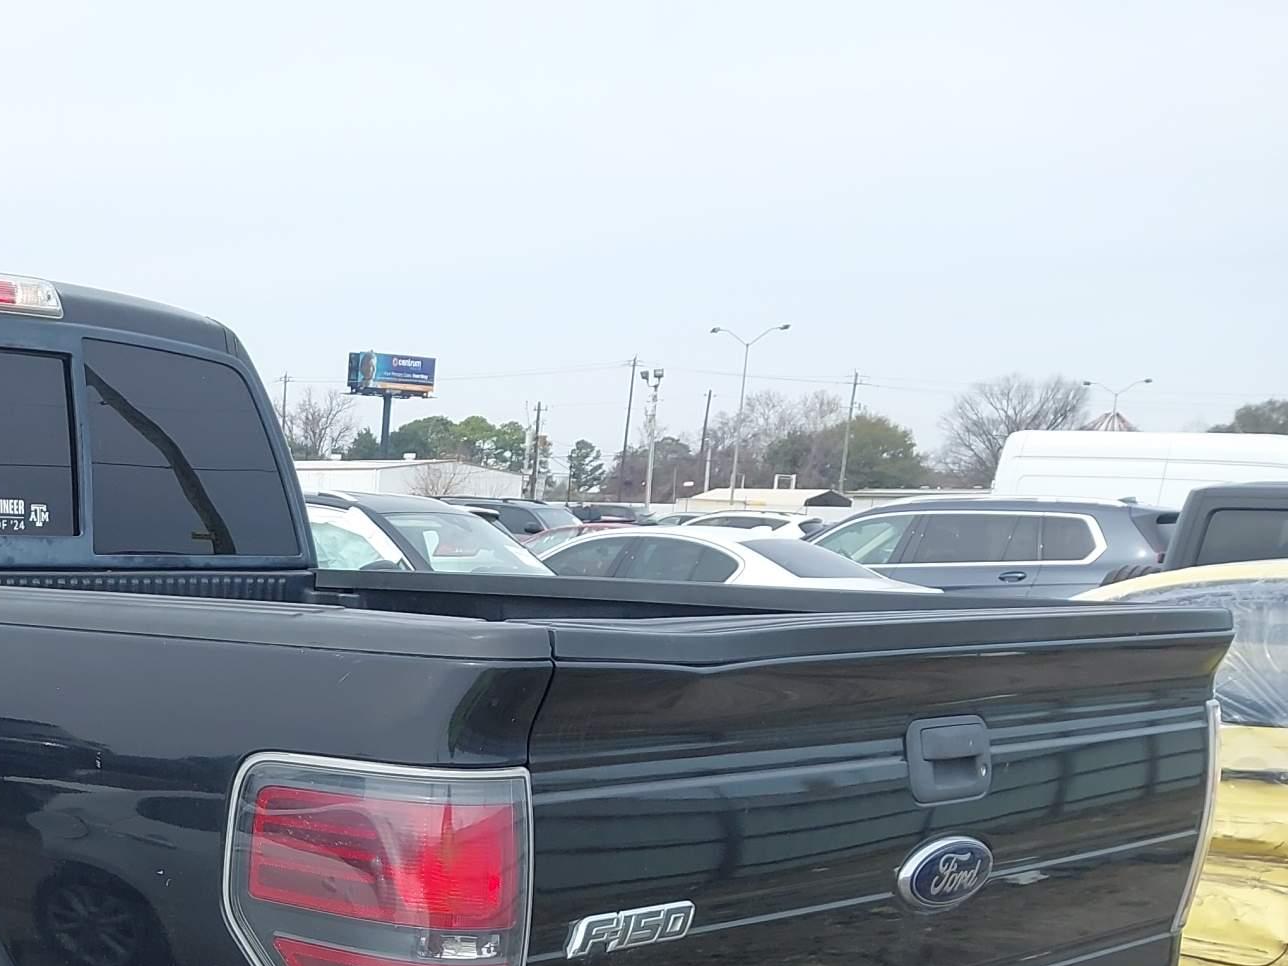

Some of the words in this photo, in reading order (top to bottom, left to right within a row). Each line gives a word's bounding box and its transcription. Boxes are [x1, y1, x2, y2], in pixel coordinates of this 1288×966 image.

[10, 520, 26, 531] '24
[930, 852, 982, 896] Ford
[567, 900, 695, 960] F-150
